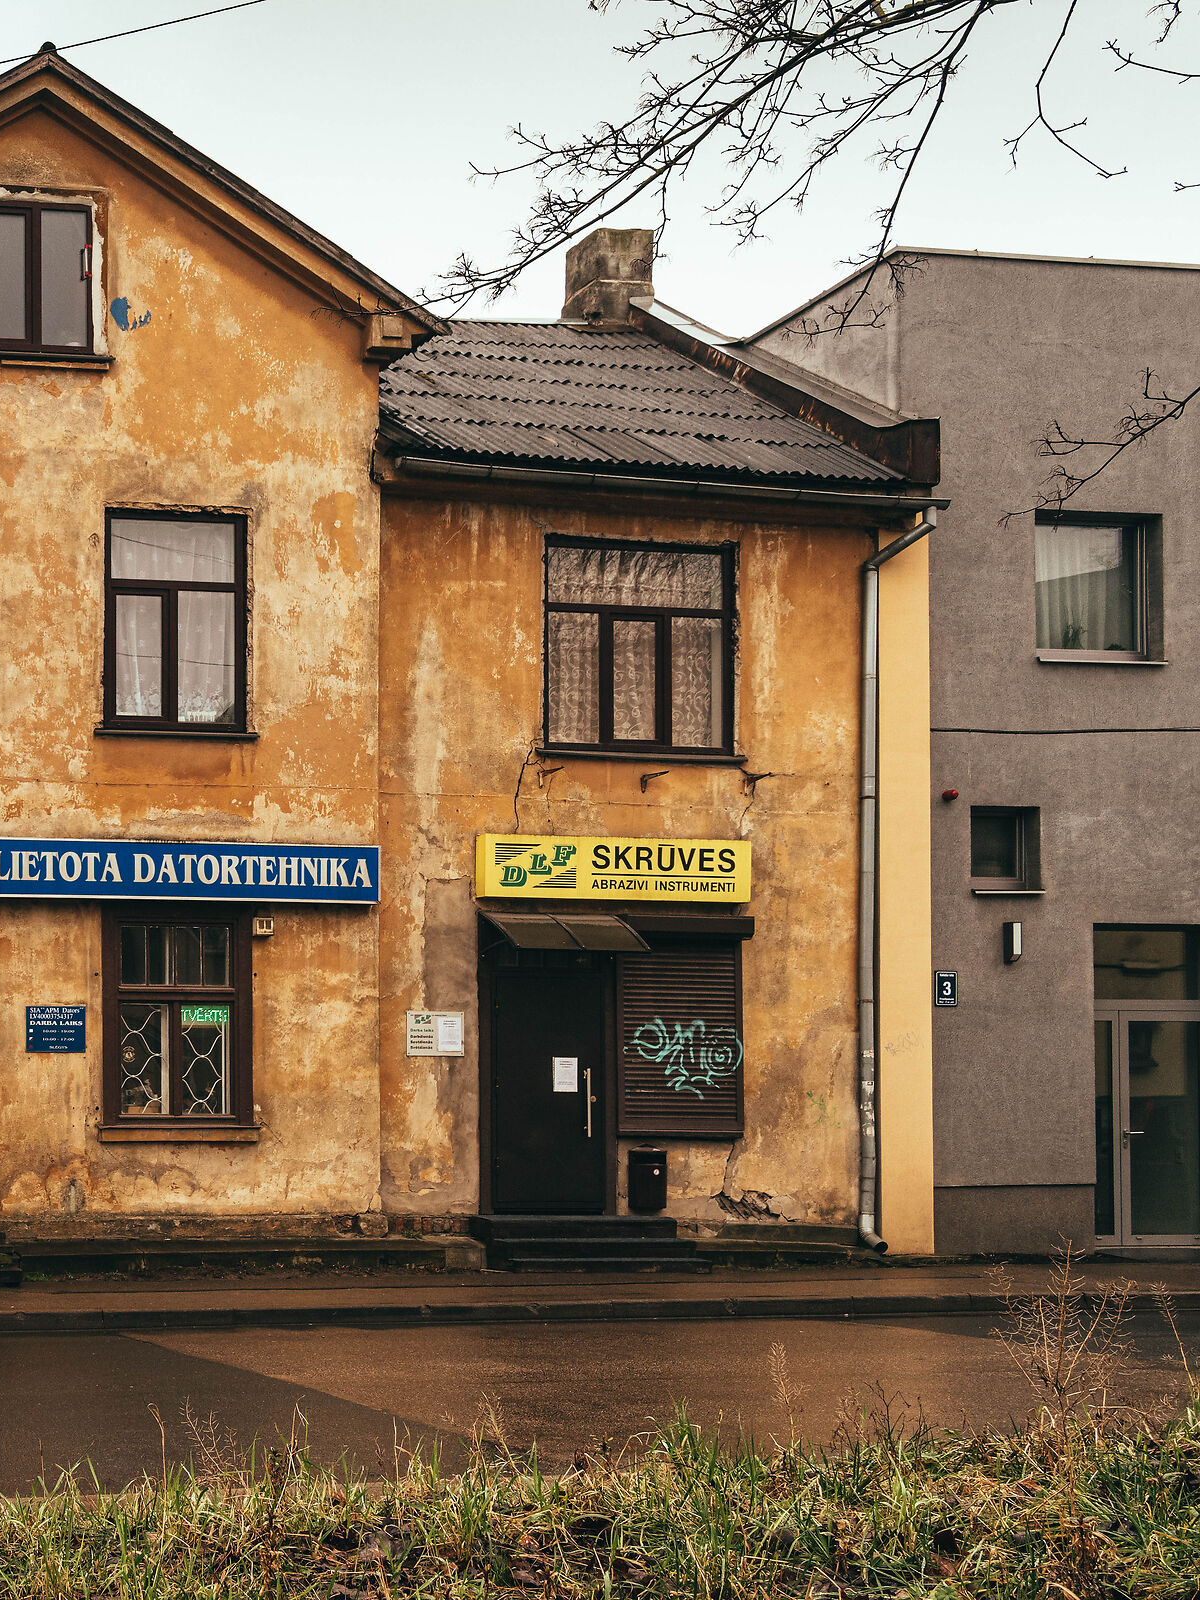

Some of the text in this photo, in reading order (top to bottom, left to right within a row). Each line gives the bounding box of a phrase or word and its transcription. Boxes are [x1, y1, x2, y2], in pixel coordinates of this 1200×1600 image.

[132, 853, 373, 888] DATORTEHNIKA
[499, 844, 577, 887] DLF
[591, 843, 736, 873] SKRŪVES
[654, 880, 736, 893] INSTRUMENTI
[942, 981, 952, 996] 3
